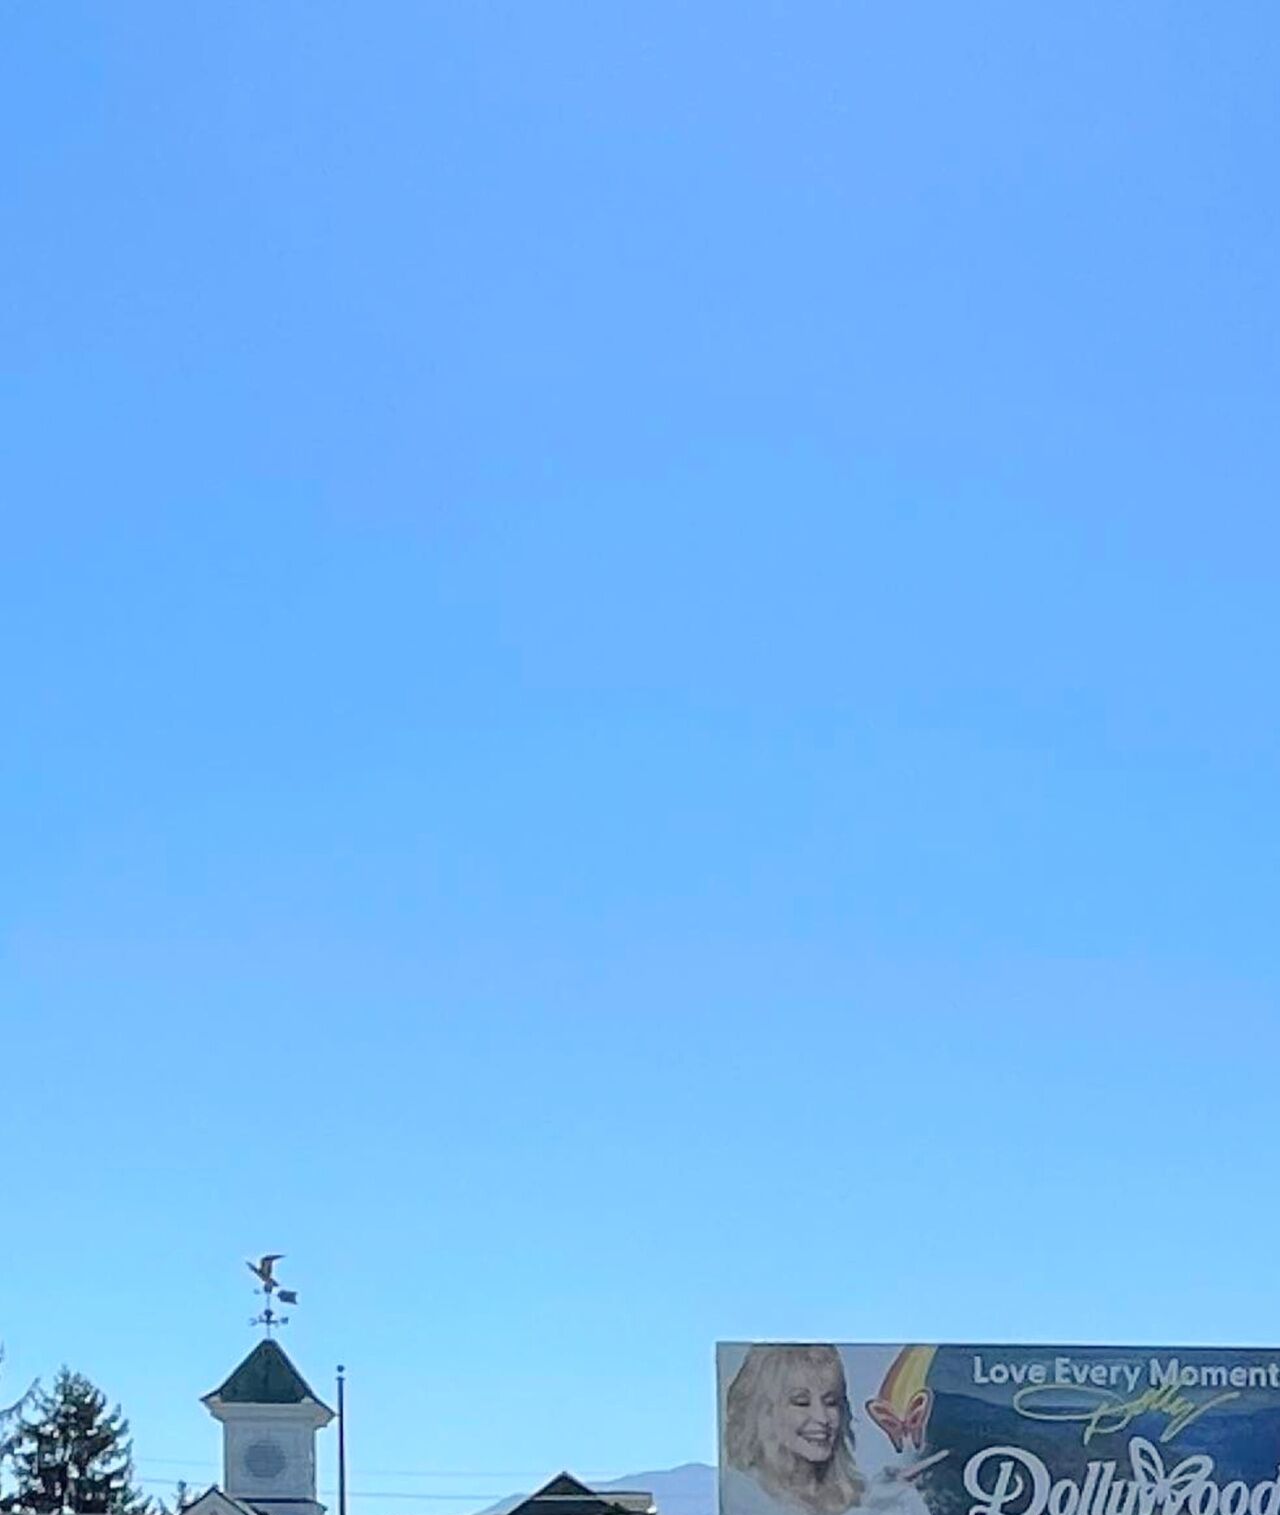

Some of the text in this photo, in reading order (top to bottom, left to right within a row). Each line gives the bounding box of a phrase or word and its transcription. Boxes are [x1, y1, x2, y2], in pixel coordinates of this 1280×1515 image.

[972, 1356, 1280, 1393] Love Every Moment
